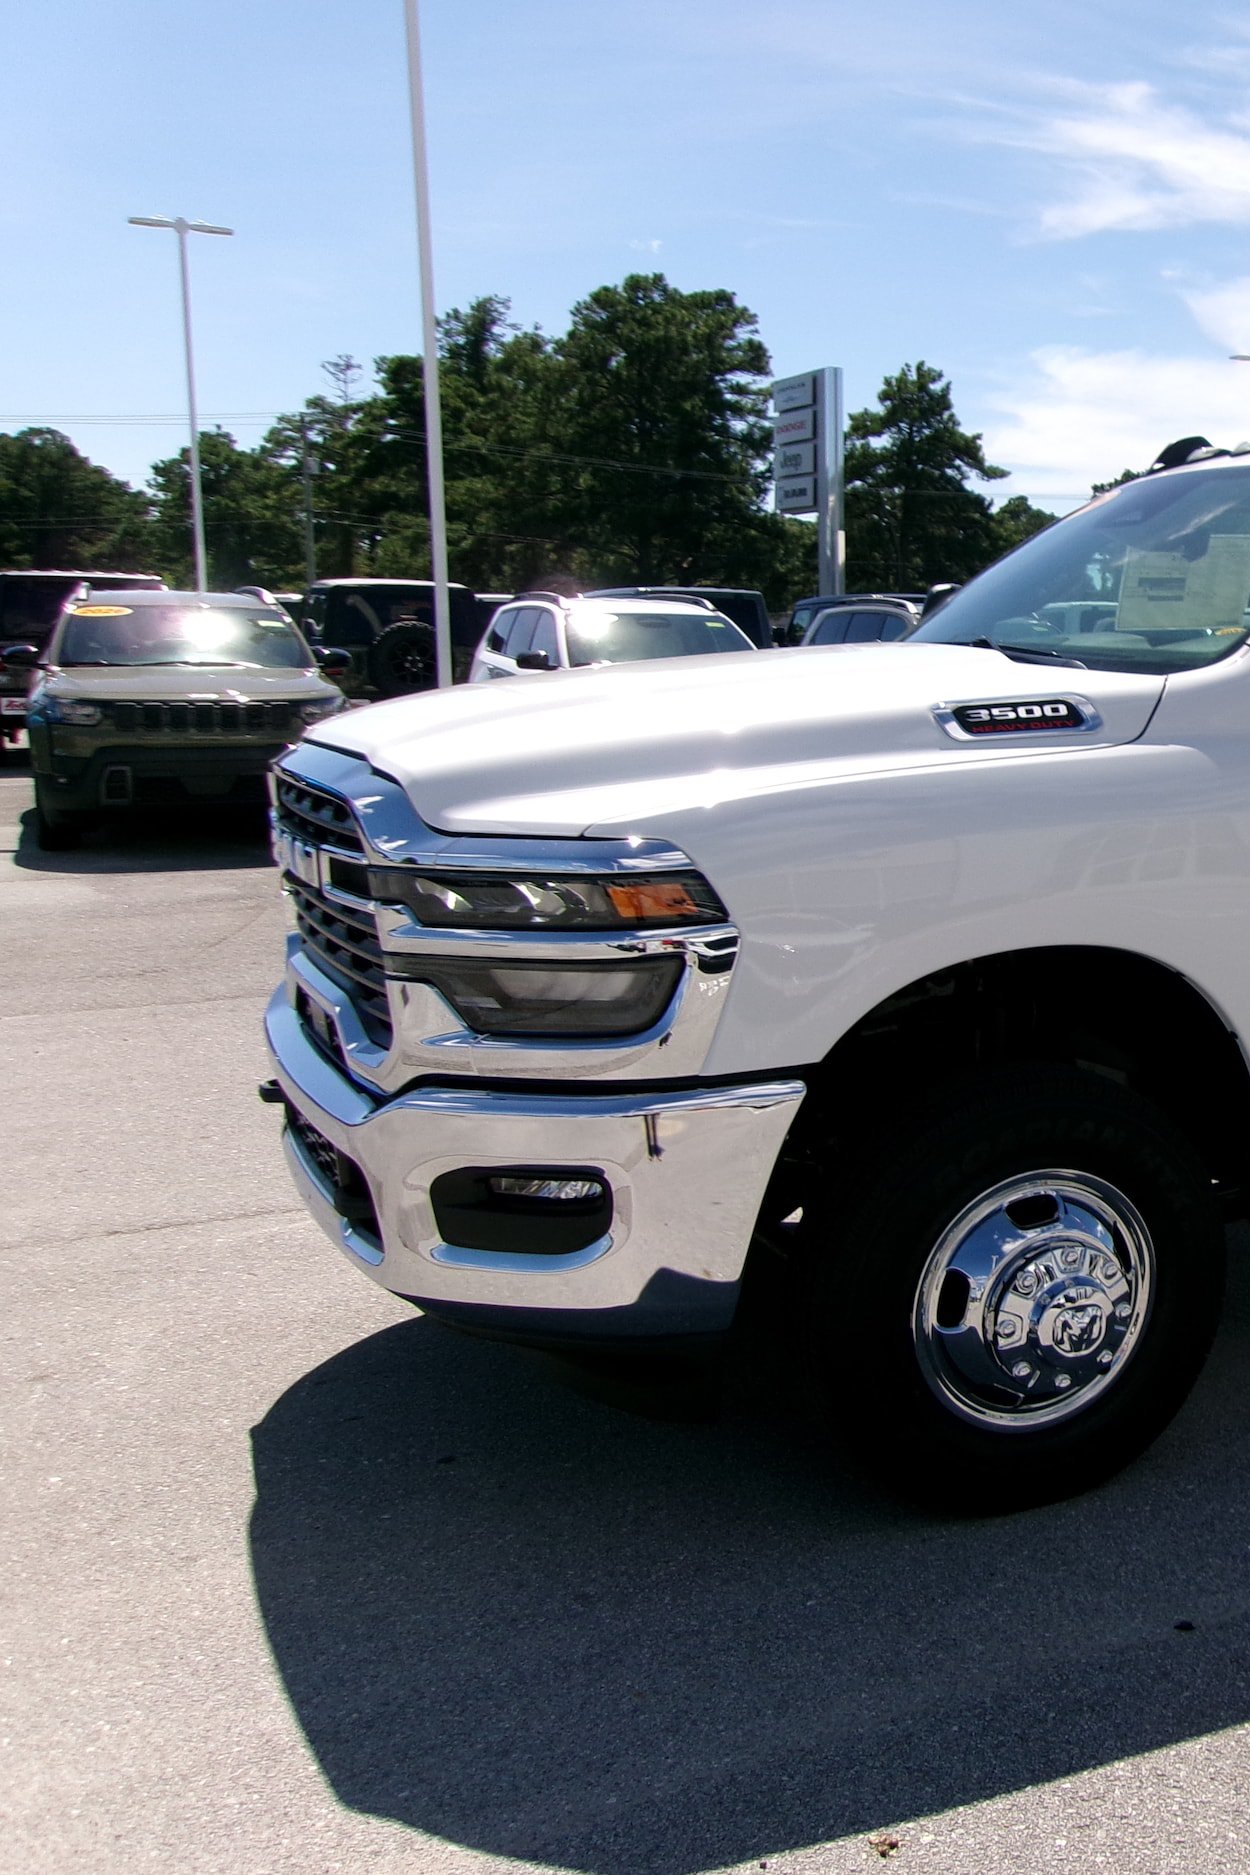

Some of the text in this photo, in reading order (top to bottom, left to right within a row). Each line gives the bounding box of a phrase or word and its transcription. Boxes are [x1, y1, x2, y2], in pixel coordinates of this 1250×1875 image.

[965, 704, 1068, 722] 3500
[971, 720, 1075, 733] HEAVY DUTY
